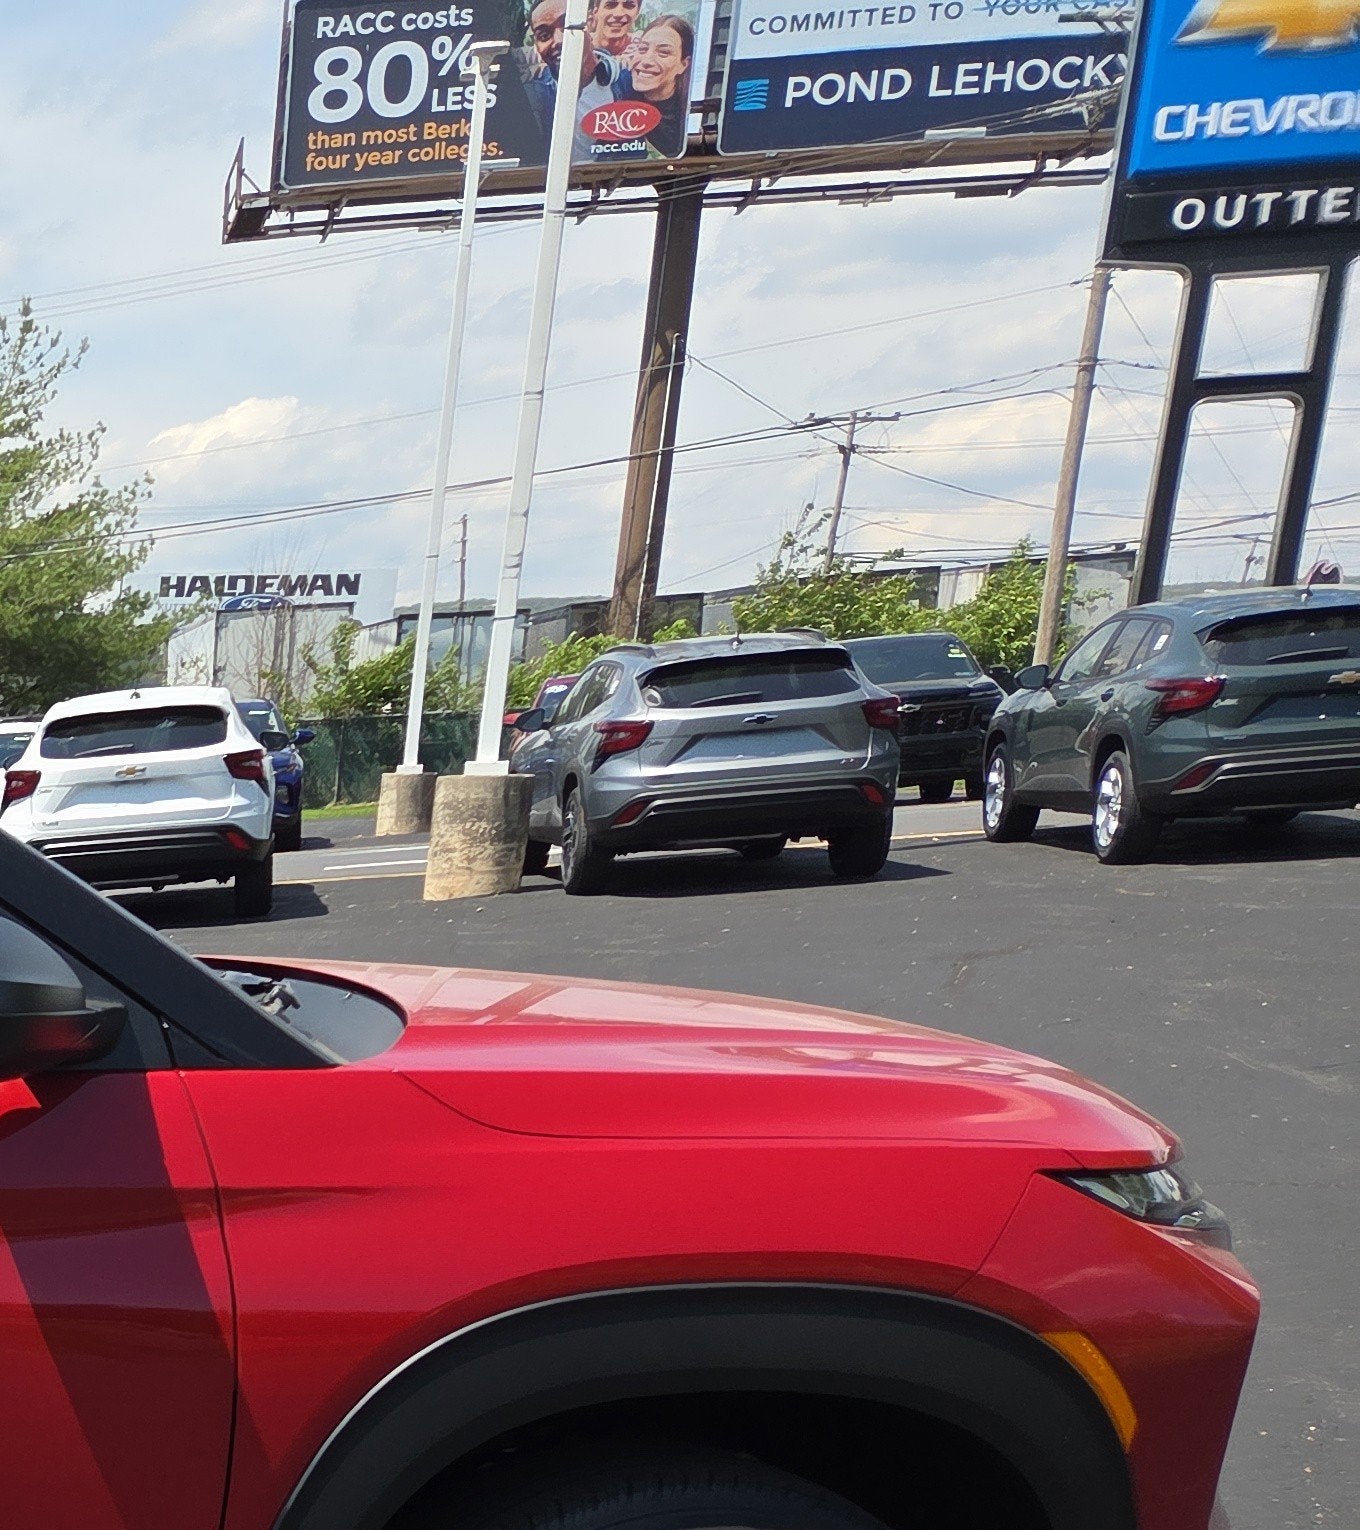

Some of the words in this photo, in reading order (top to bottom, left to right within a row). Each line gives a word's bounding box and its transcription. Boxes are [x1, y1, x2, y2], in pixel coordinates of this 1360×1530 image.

[316, 10, 395, 38] RACC
[401, 4, 474, 31] costs
[748, 4, 916, 36] COMMITTED
[929, 1, 964, 21] TO
[431, 83, 498, 113] LESS
[784, 68, 913, 108] POND
[307, 130, 356, 150] than
[361, 123, 418, 146] most
[423, 118, 472, 140] Berk
[593, 108, 648, 138] RACC
[305, 152, 350, 172] four
[353, 150, 403, 172] year
[590, 140, 647, 154] racc.edu
[1172, 186, 1360, 230] OUTTE
[159, 573, 362, 598] HALDEMAN
